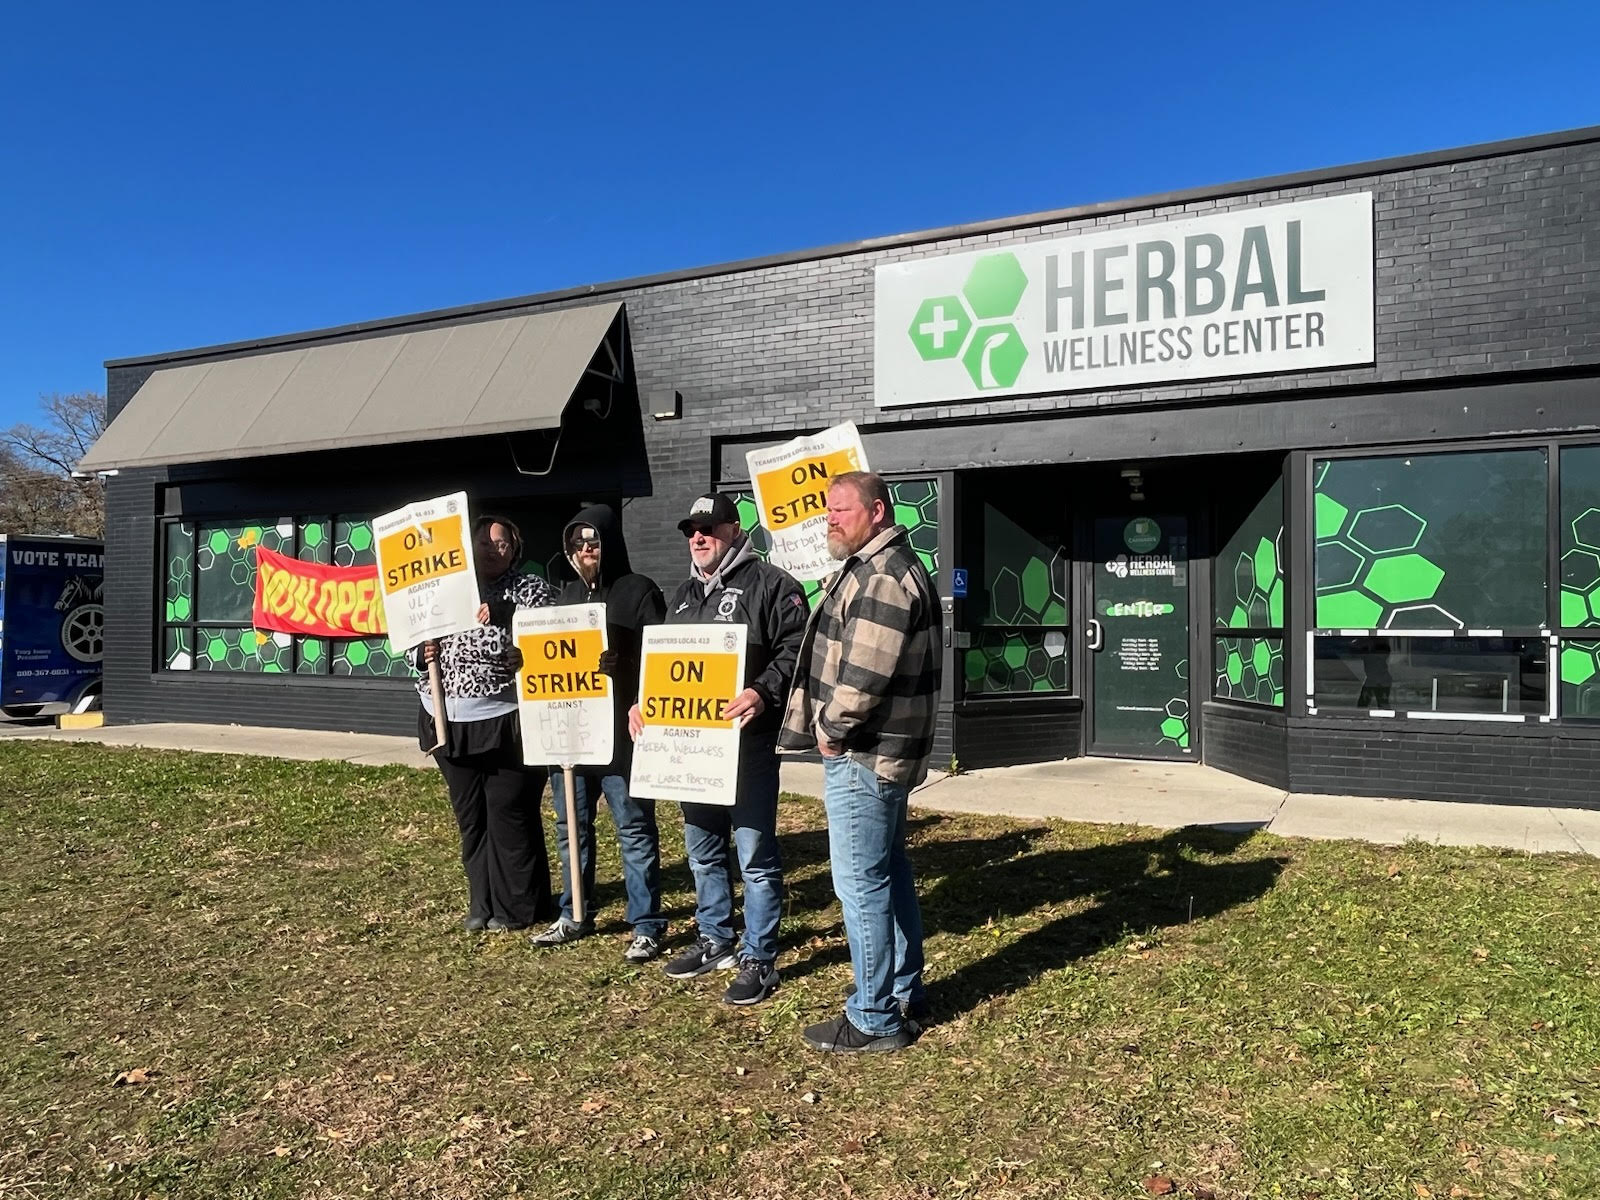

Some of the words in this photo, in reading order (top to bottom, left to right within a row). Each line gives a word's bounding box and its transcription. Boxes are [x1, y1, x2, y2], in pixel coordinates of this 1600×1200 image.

[1045, 220, 1326, 333] HERBAL
[1043, 325, 1194, 374] WELLNESS
[1202, 311, 1325, 358] CENTER
[754, 452, 792, 467] TEAMSTERS
[791, 445, 812, 456] LOCAL
[791, 462, 828, 485] ON
[771, 490, 827, 524] STRI
[801, 516, 828, 532] AGAIN
[403, 527, 433, 551] ON
[773, 534, 818, 554] Herbal
[12, 550, 59, 567] VOTE
[387, 549, 462, 587] STRIKE
[1129, 555, 1176, 569] HERBAL
[407, 579, 441, 595] AGAINST
[408, 590, 435, 610] ULP
[408, 604, 445, 626] HWC
[544, 638, 577, 660] ON
[647, 637, 678, 645] TEAMSTERS
[678, 637, 697, 645] LOCAL
[697, 637, 710, 645] 413
[526, 671, 603, 694] STRIKE
[669, 660, 704, 683] ON
[547, 700, 584, 710] AGAINST
[645, 696, 729, 721] STRIKE
[663, 728, 701, 739] AGAINST
